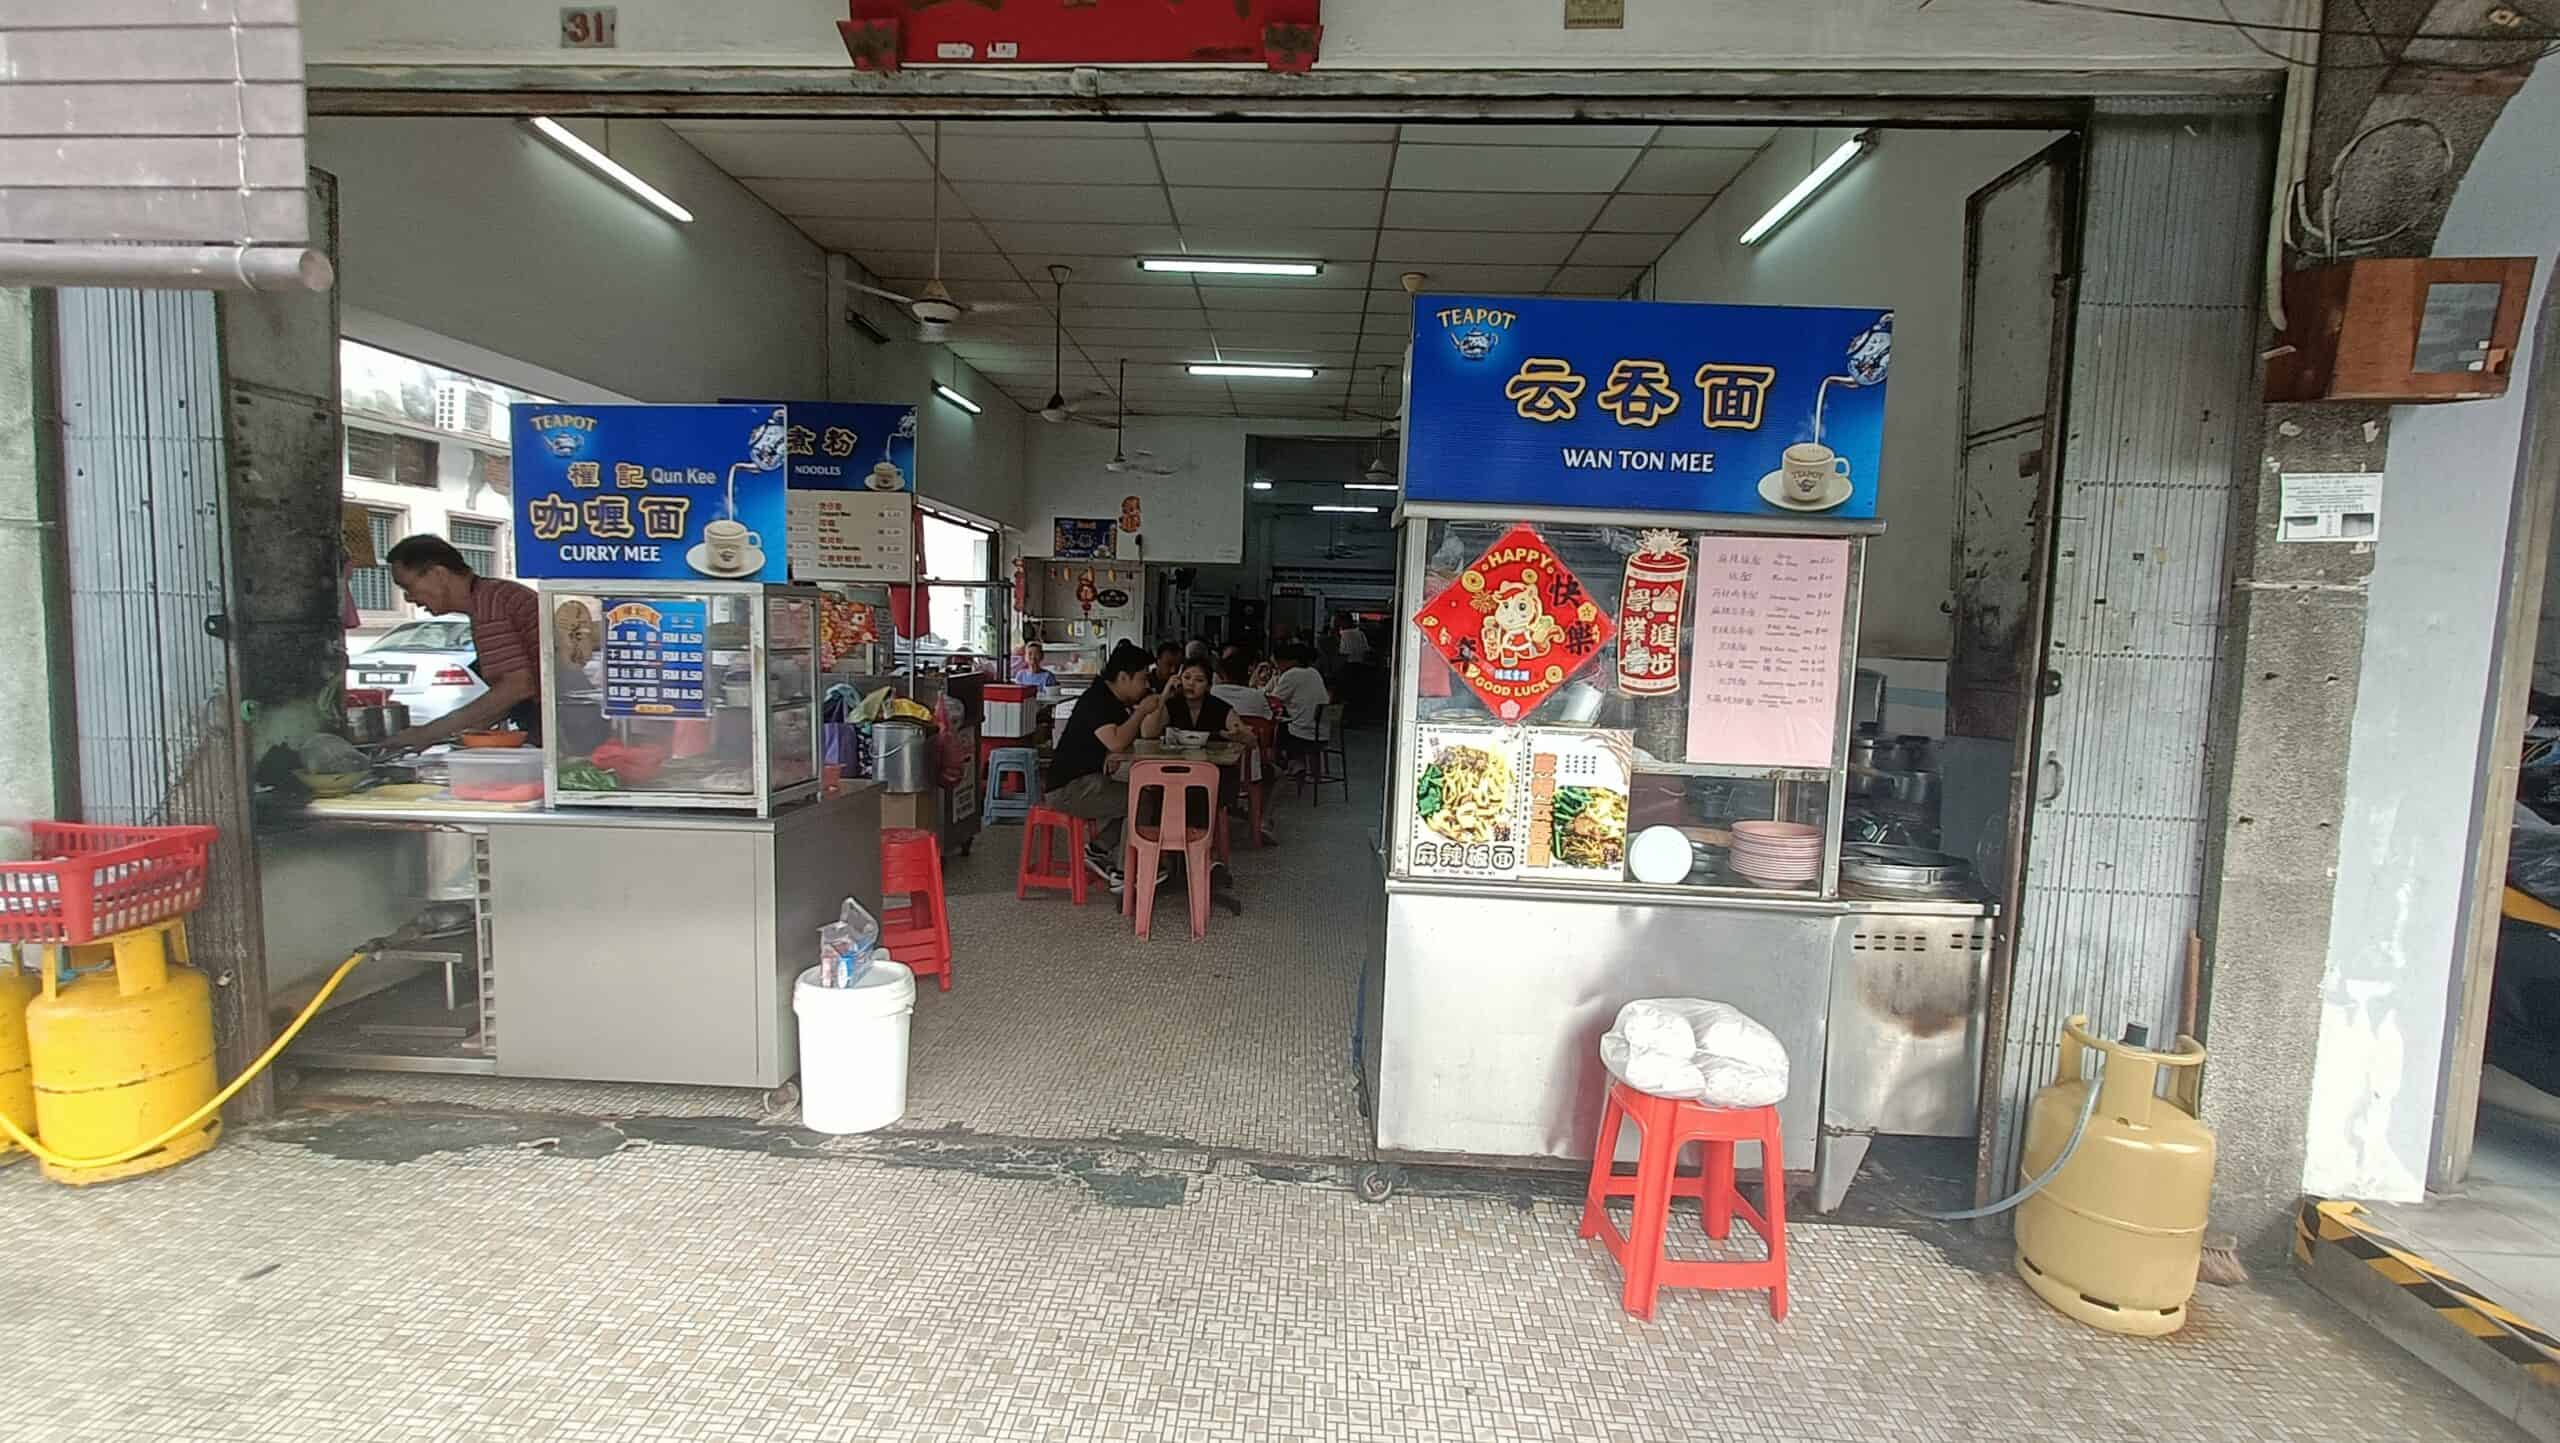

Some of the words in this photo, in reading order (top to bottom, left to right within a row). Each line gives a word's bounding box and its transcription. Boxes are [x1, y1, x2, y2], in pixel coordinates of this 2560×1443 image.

[567, 11, 604, 43] 31
[1436, 307, 1517, 331] TEAPOT
[1505, 357, 1775, 430] 云吞面
[530, 414, 598, 432] TEAPOT
[794, 465, 842, 476] NOODLES
[1563, 448, 1614, 469] WAN
[1618, 450, 1667, 471] TON
[1670, 452, 1715, 473] MEE
[651, 468, 682, 485] Qun
[687, 469, 717, 485] Kee
[530, 493, 690, 540] 咖喱面
[559, 545, 619, 562] CURRY
[623, 546, 661, 562] MEE
[1487, 548, 1548, 569] HAPPY
[1474, 677, 1511, 697] GOOD
[1513, 681, 1551, 697] LUCK
